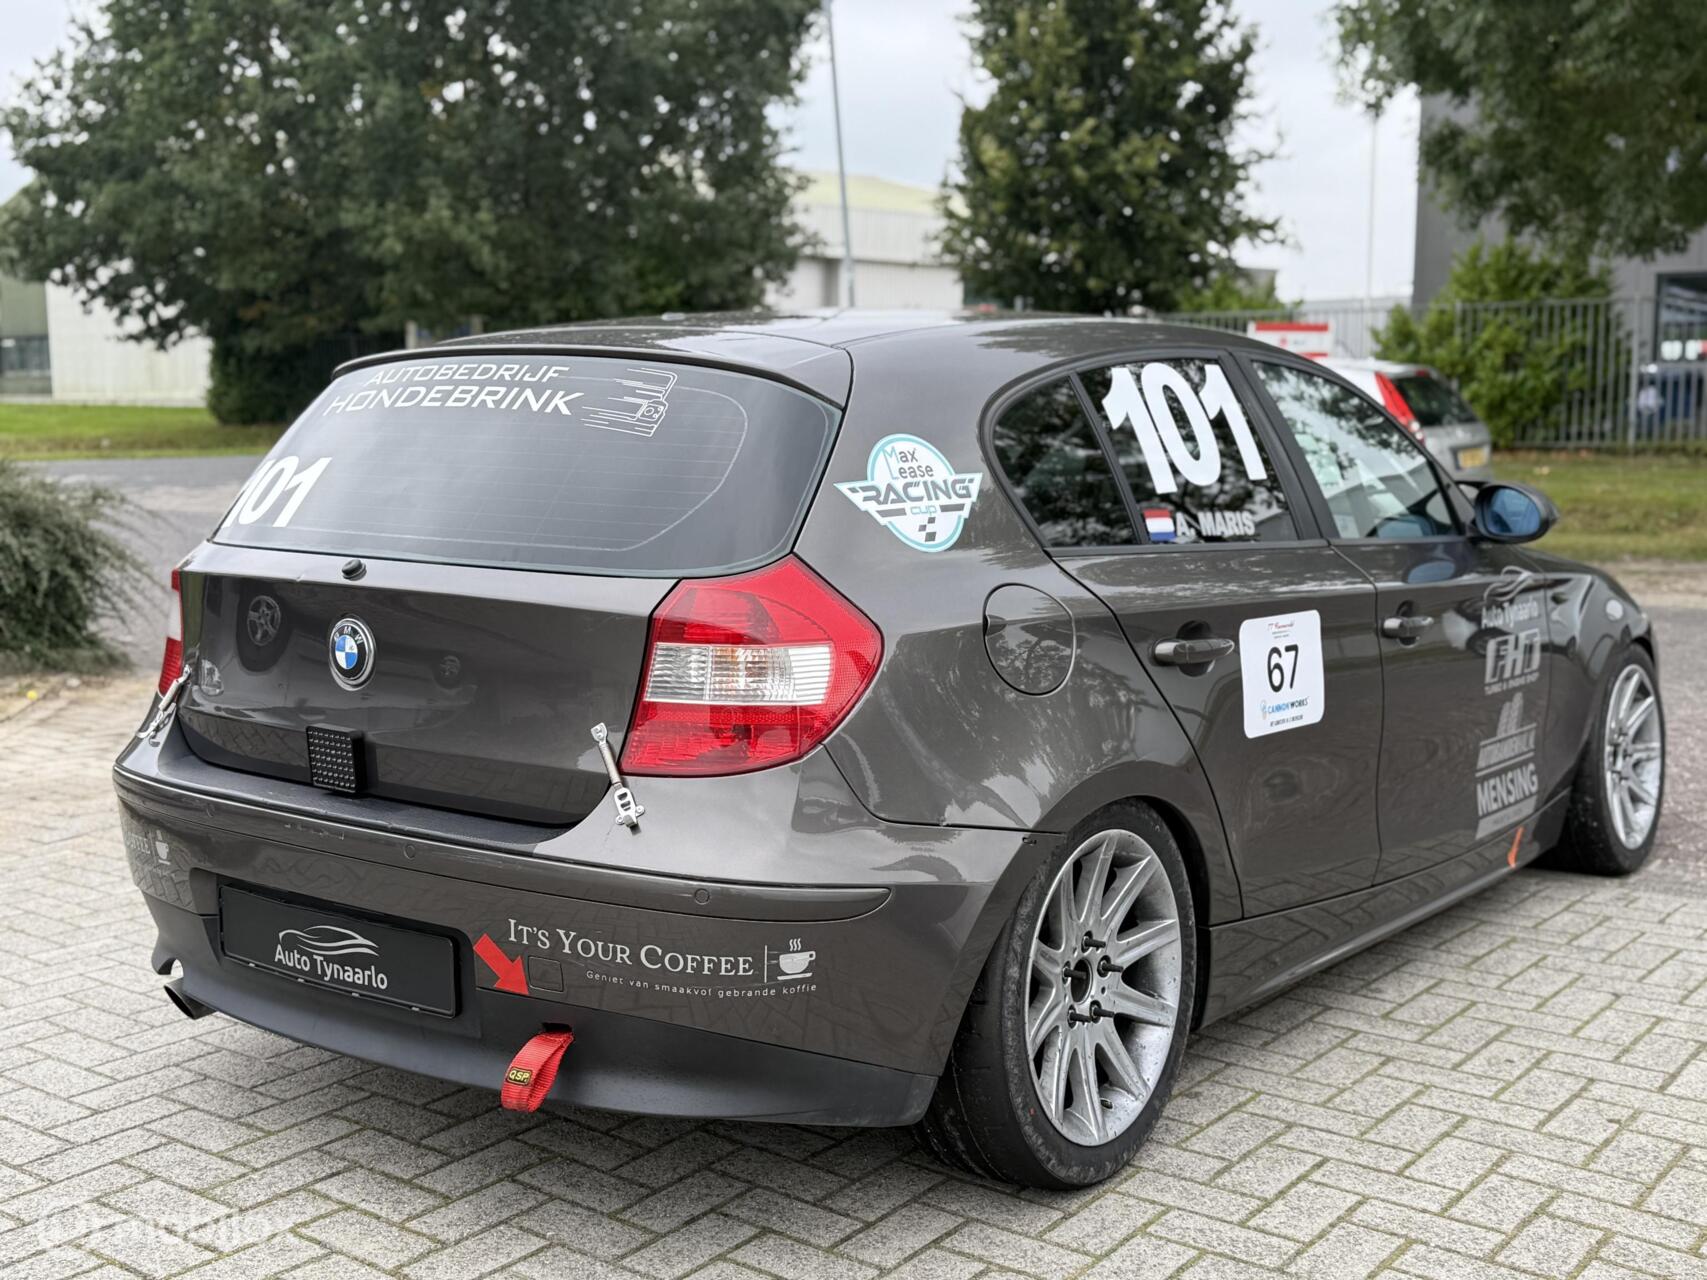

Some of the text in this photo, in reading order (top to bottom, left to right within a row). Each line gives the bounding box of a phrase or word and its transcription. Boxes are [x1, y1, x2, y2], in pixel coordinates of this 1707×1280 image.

[366, 363, 570, 386] AUTOBEDRIJF
[323, 385, 585, 416] HONDEBRINK
[1102, 362, 1268, 495] 101
[883, 446, 918, 464] Max
[888, 463, 934, 480] Lease
[847, 478, 975, 505] RACING
[1197, 511, 1256, 537] MARIS
[333, 625, 364, 644] BMW
[1267, 644, 1299, 693] 67
[1477, 762, 1538, 817] MENSING
[274, 943, 388, 990] Auto Tynaarlo
[586, 969, 817, 998] Geniet van smaakvol gebrande koffie
